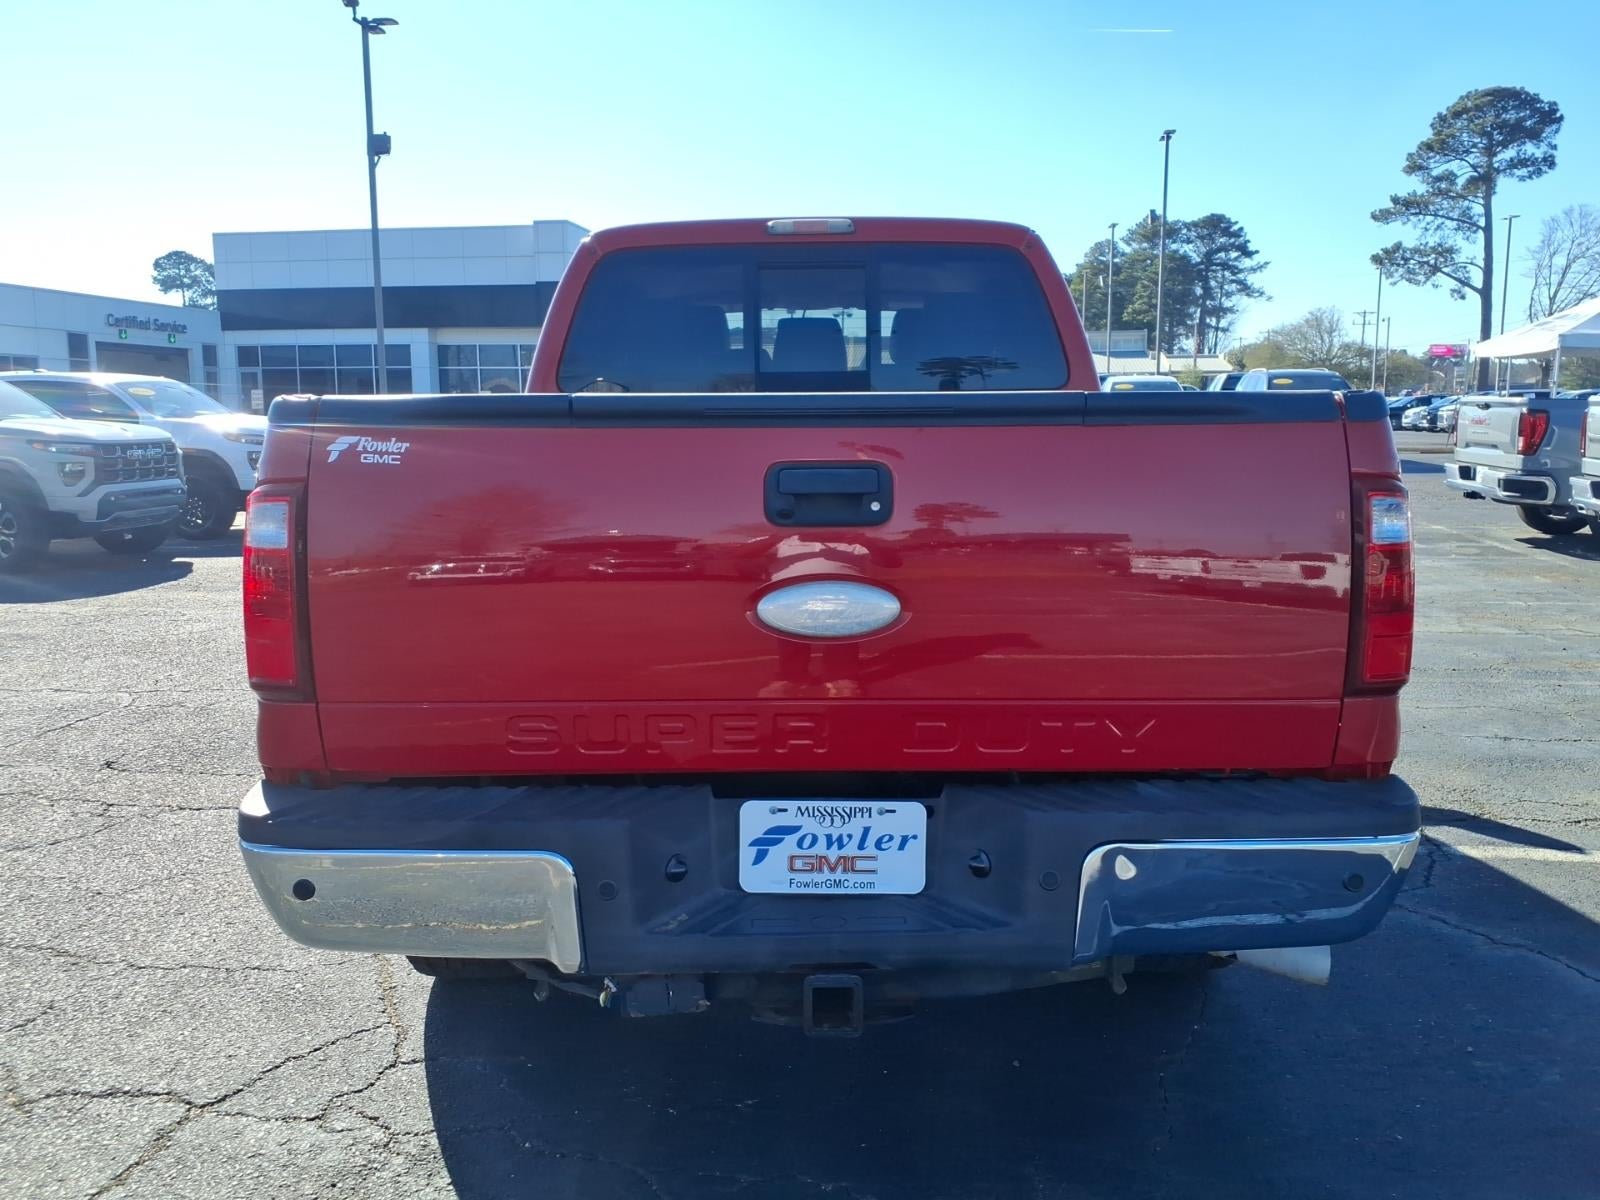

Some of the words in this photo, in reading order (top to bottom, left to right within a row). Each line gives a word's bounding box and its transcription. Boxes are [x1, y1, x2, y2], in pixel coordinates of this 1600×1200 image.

[106, 312, 150, 331] Certified
[153, 317, 188, 334] Service
[356, 436, 410, 453] Fowler
[360, 453, 401, 465] GMC
[505, 713, 828, 755] SUPER
[902, 713, 1157, 755] DUTY
[794, 805, 873, 829] MISSISSIPPI
[787, 853, 879, 875] GMC
[788, 877, 876, 890] FowlerGMC.com
